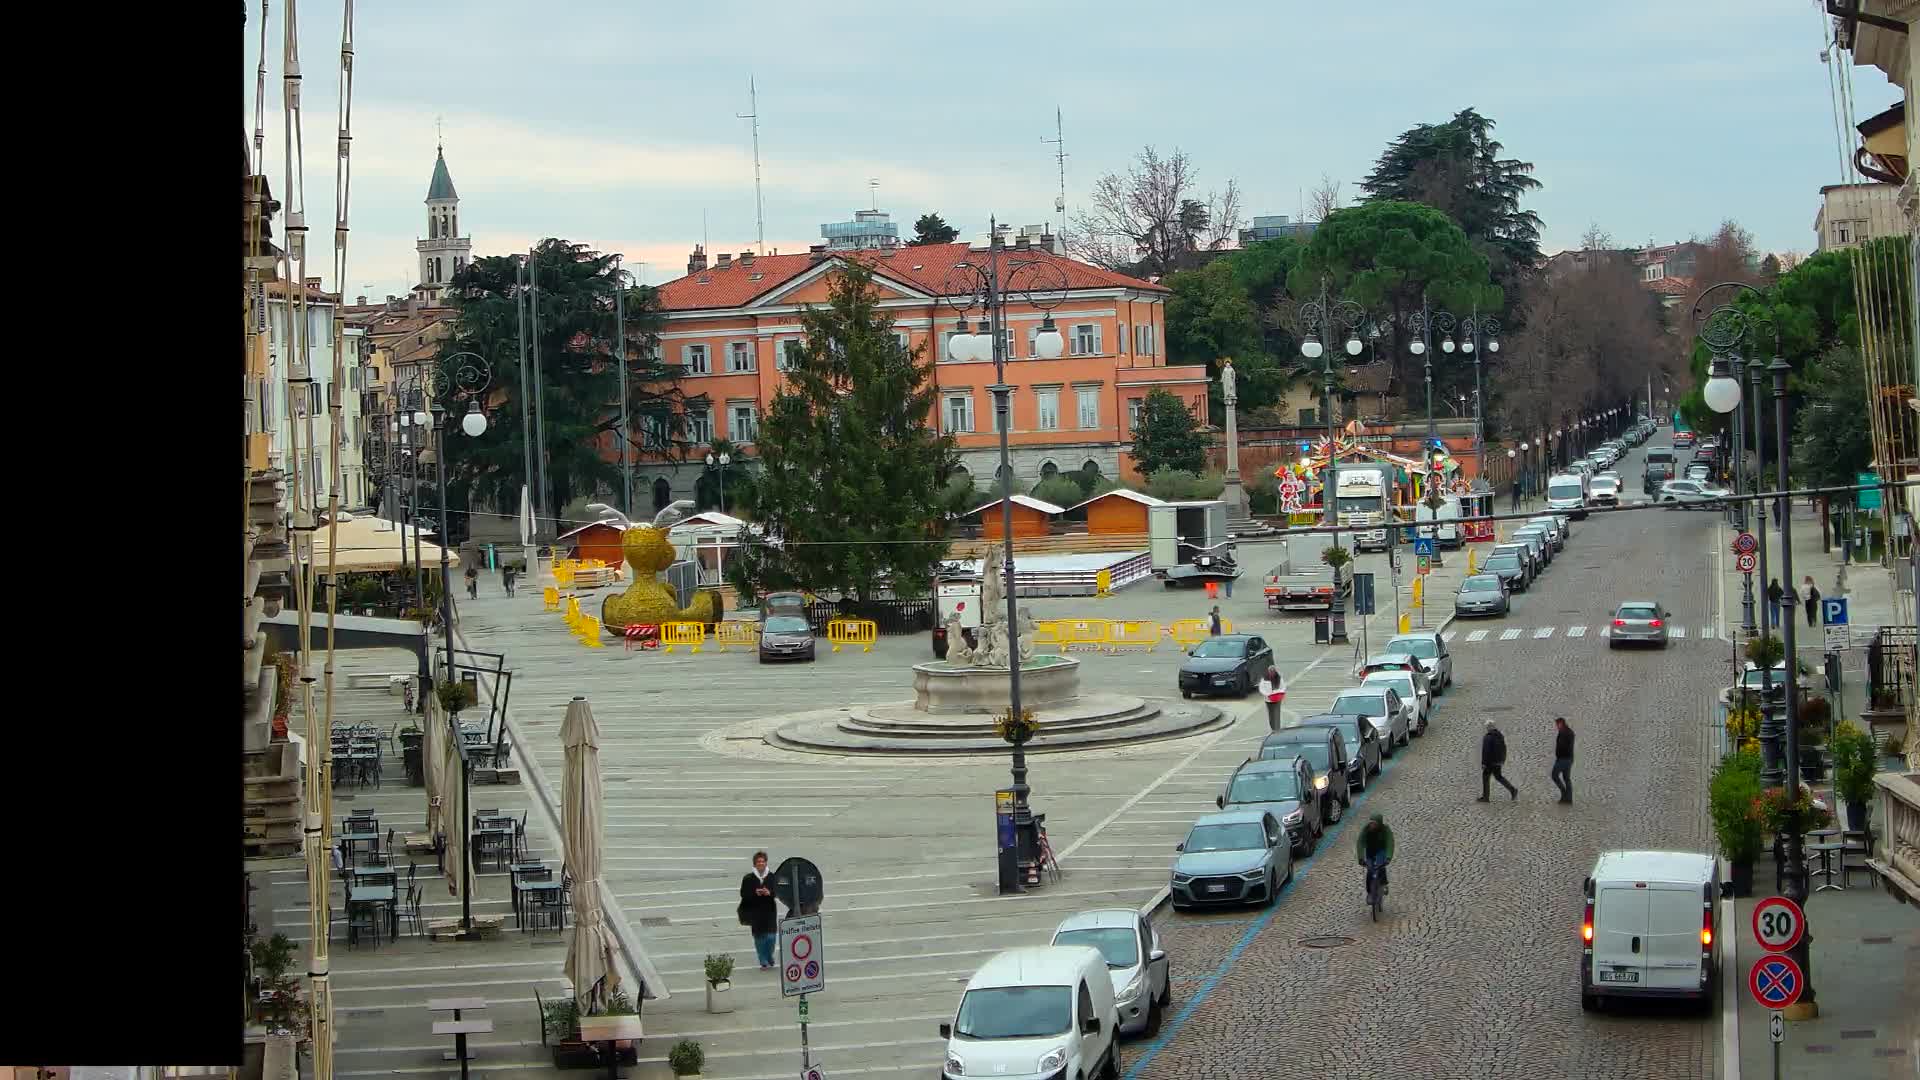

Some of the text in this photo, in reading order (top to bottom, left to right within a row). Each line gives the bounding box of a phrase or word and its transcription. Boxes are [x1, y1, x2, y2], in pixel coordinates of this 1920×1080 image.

[1742, 557, 1752, 567] 20
[1827, 602, 1842, 622] P
[1762, 911, 1792, 938] 30
[790, 968, 799, 979] 20
